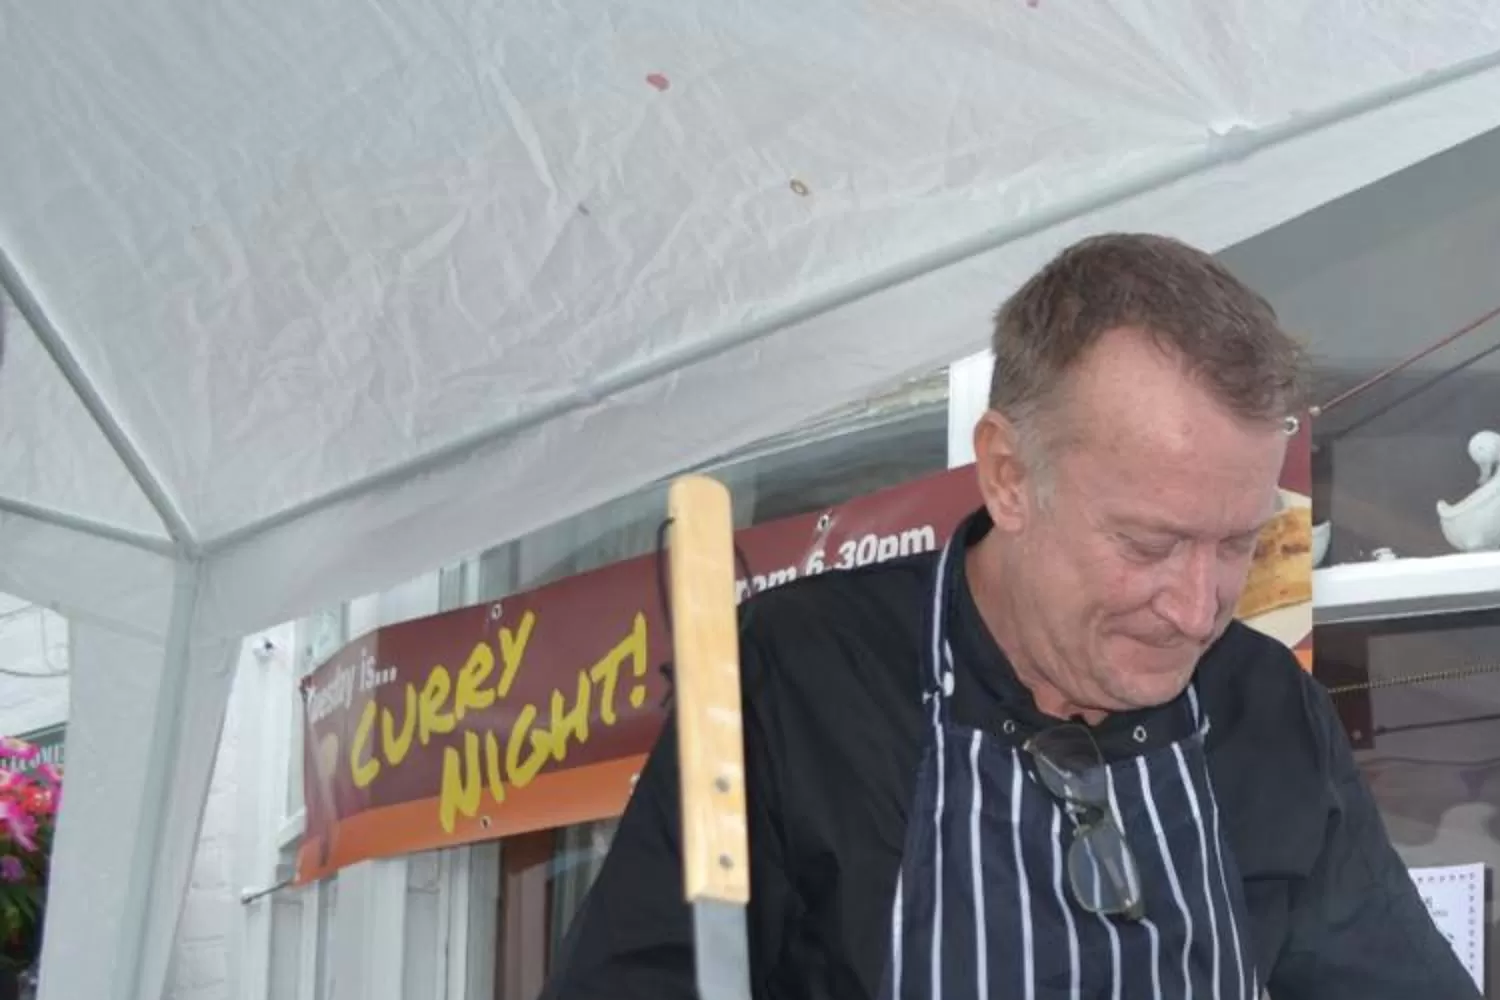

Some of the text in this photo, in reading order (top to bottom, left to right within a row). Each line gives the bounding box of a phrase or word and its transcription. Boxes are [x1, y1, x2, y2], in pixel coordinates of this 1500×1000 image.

[735, 565, 797, 604] rom
[351, 610, 535, 788] CURRY
[439, 610, 647, 833] NIGHT!
